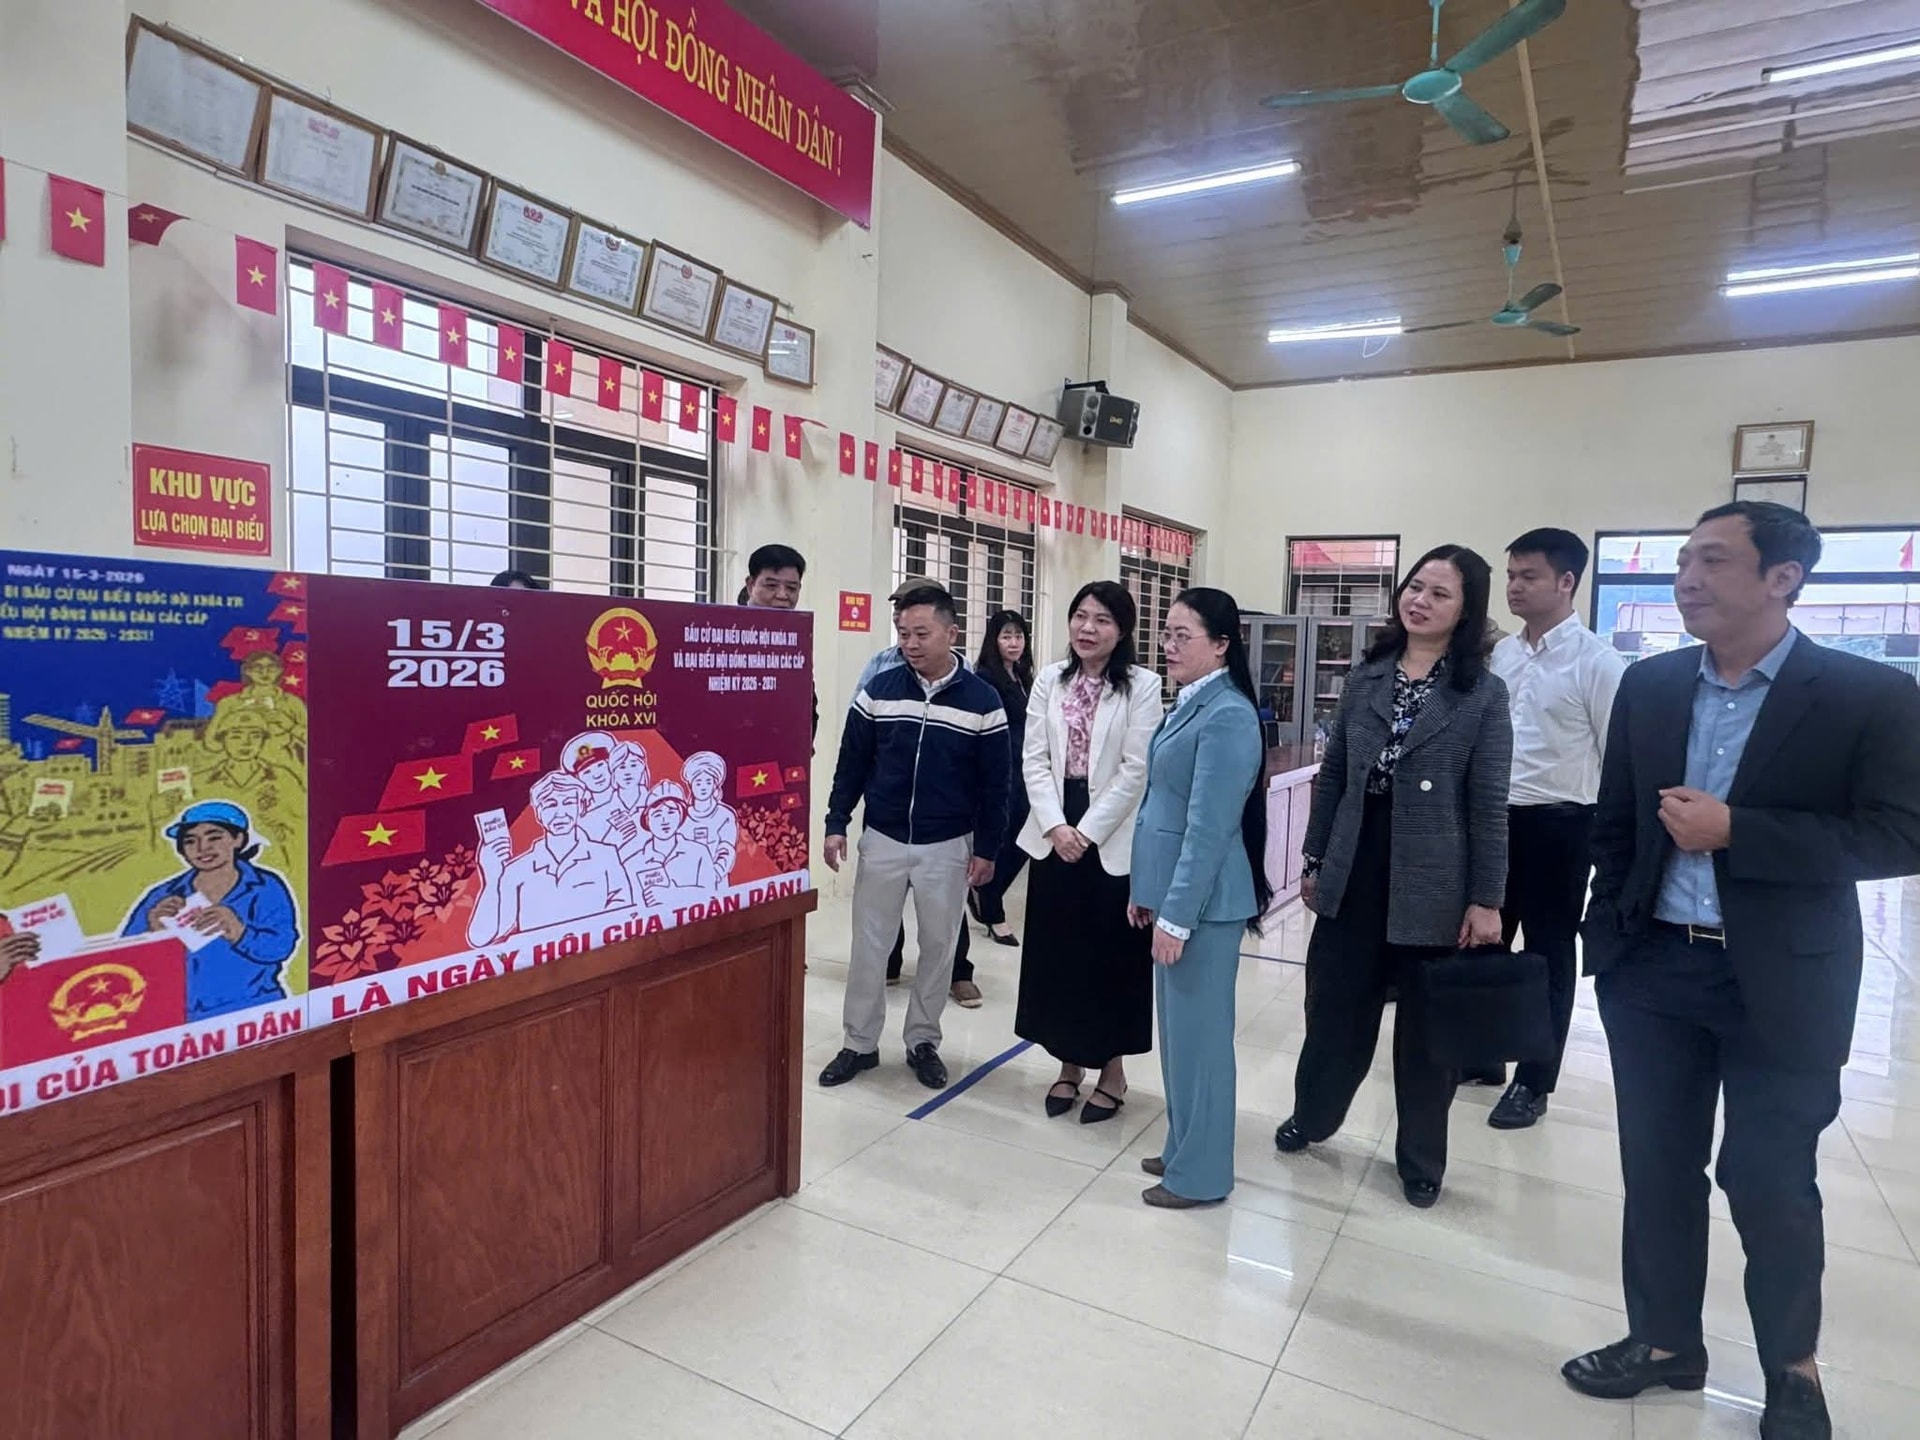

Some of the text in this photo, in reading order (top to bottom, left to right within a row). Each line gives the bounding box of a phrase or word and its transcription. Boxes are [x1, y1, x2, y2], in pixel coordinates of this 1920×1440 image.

[665, 7, 730, 104] ĐỒNG
[735, 65, 793, 143] NHÂN
[150, 467, 256, 509] KHU VỰC
[141, 508, 264, 542] LỰA CHỌN ĐẠI BIỂU
[387, 619, 505, 650] 15/3
[387, 658, 505, 687] 2026
[586, 689, 657, 709] QUỐC HỘI
[586, 710, 657, 728] KHÓA XVI
[332, 982, 392, 1020] LÀ
[407, 950, 519, 999] NGÀY
[603, 911, 664, 945] CỦA
[672, 893, 740, 927] TOÀN
[37, 1055, 119, 1101] CỦA
[129, 1028, 225, 1075] TOÀN
[237, 1008, 302, 1045] DÂN
